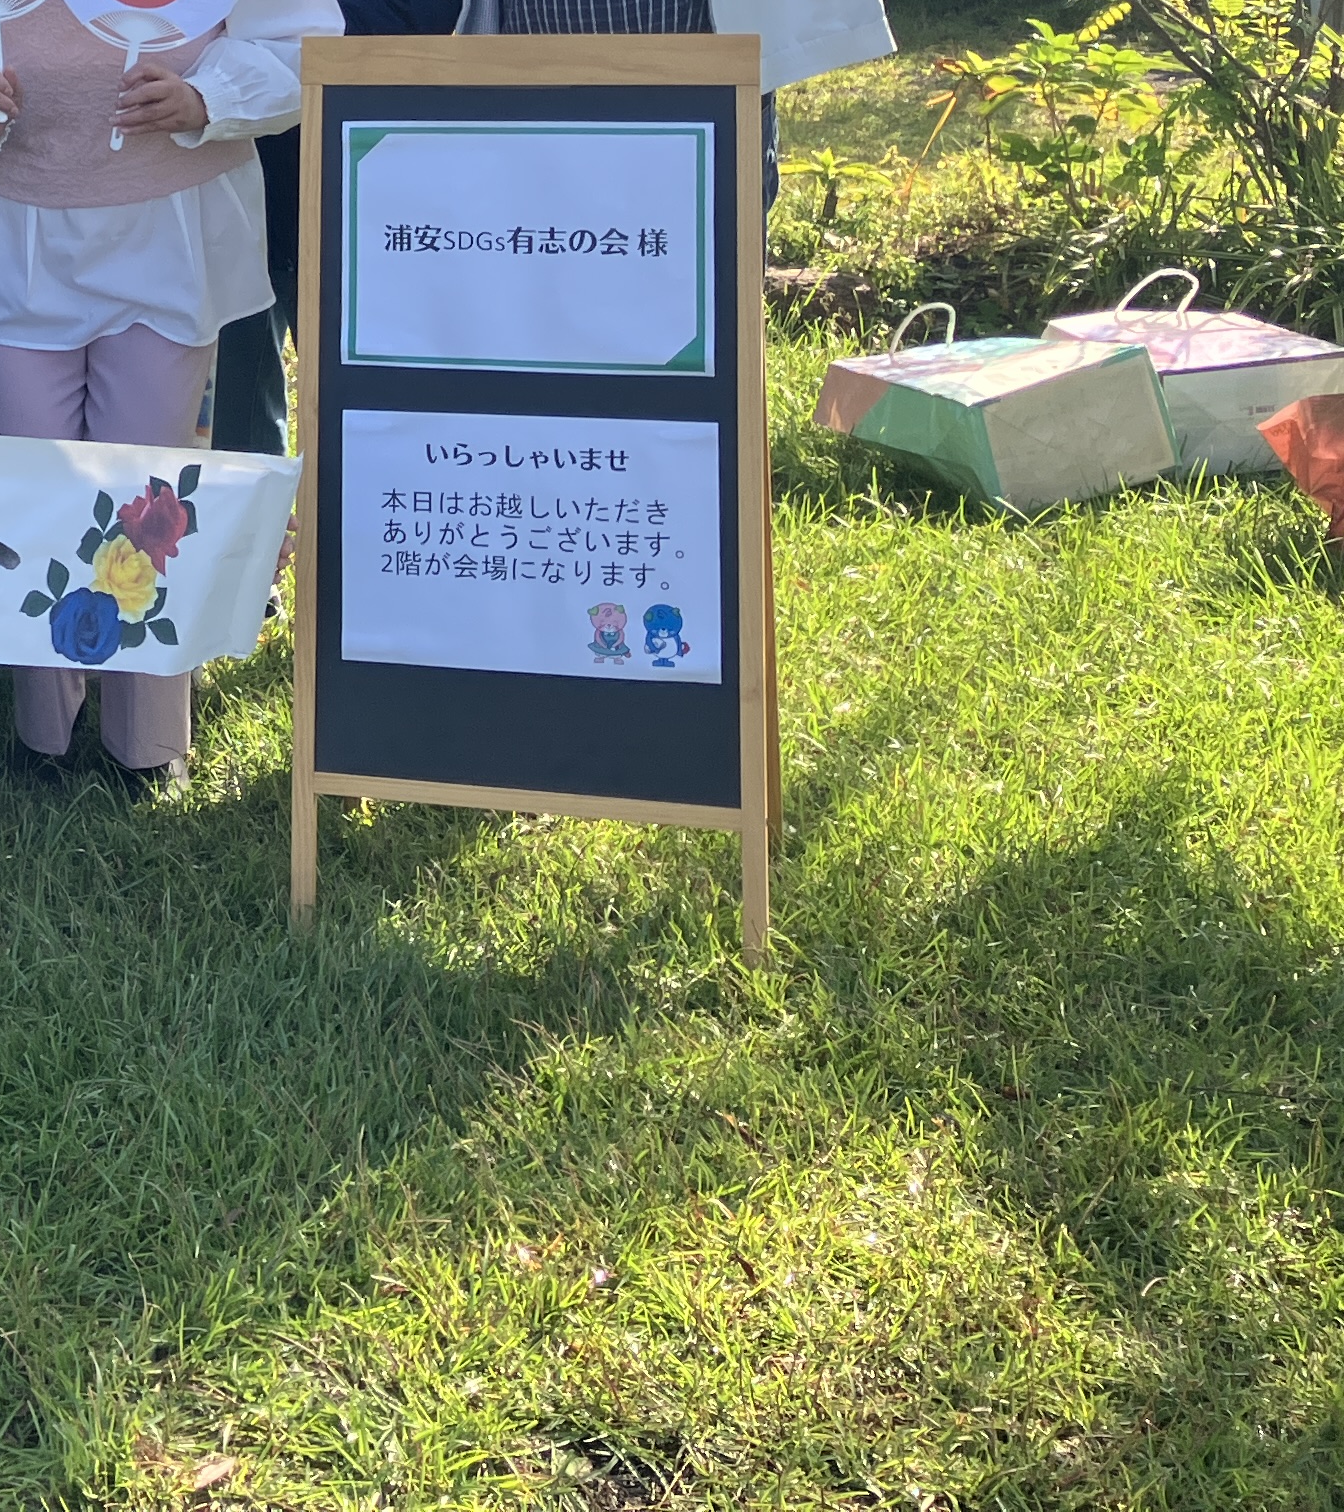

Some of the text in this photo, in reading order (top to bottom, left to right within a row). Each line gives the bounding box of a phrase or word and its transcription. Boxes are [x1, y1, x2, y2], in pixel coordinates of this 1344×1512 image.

[384, 224, 668, 257] 浦安SDGs有志の会 様
[425, 442, 630, 472] いらっしゃいませ
[381, 487, 670, 526] 本日はお越しいただき
[382, 519, 685, 559] ありがとうございます。
[381, 550, 671, 590] 2階が会場になります。
